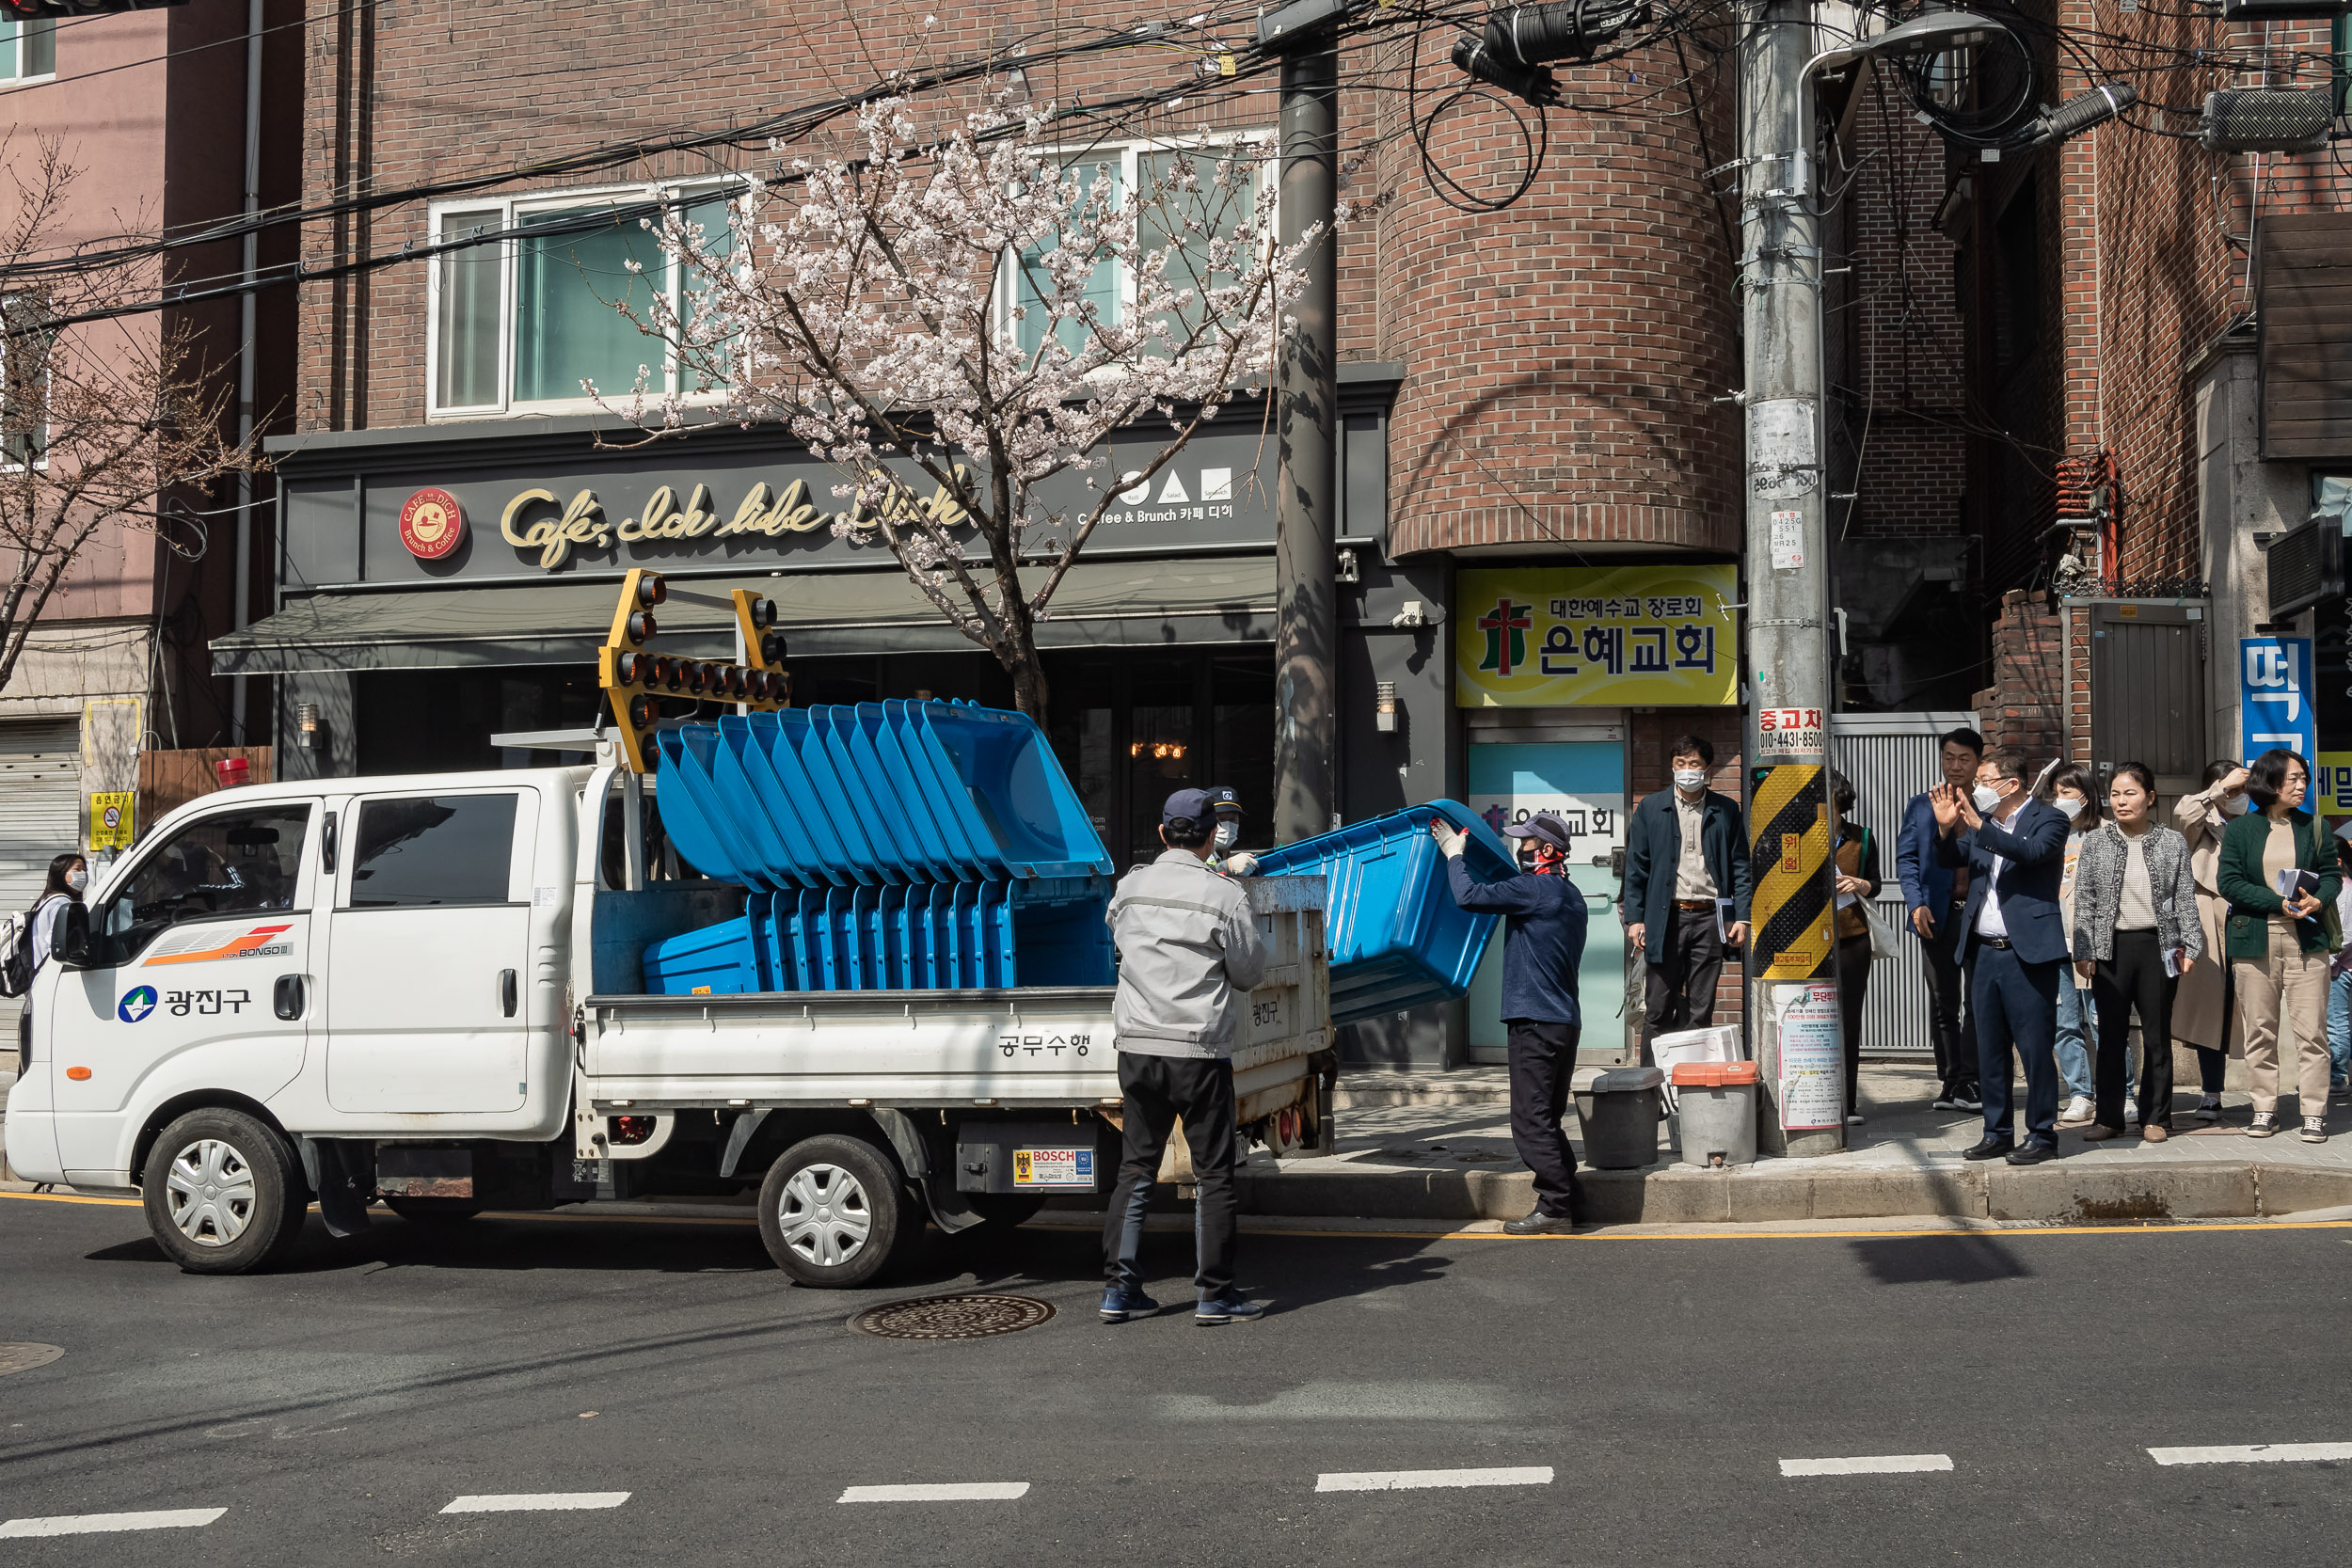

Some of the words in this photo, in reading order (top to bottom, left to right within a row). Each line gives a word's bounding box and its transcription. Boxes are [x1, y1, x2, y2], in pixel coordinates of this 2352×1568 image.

[404, 495, 425, 522] CAFE
[436, 494, 456, 519] DICH
[1077, 513, 1121, 526] Cfee
[1124, 511, 1135, 523] &
[1136, 508, 1177, 523] Brunch
[1180, 507, 1204, 521] 카페
[404, 529, 426, 553] Brunch
[427, 545, 435, 553] &
[435, 527, 455, 550] Coffee
[1550, 597, 1640, 619] 대한예수교
[1647, 596, 1701, 619] 장로회
[1540, 624, 1714, 674] 은혜교회
[1760, 709, 1822, 732] 중고차
[239, 946, 279, 958] BONGO
[165, 989, 251, 1017] 광진구
[1252, 1001, 1278, 1026] 광진구
[998, 1034, 1090, 1057] 공무수행
[1033, 1150, 1074, 1162] BOSCH
